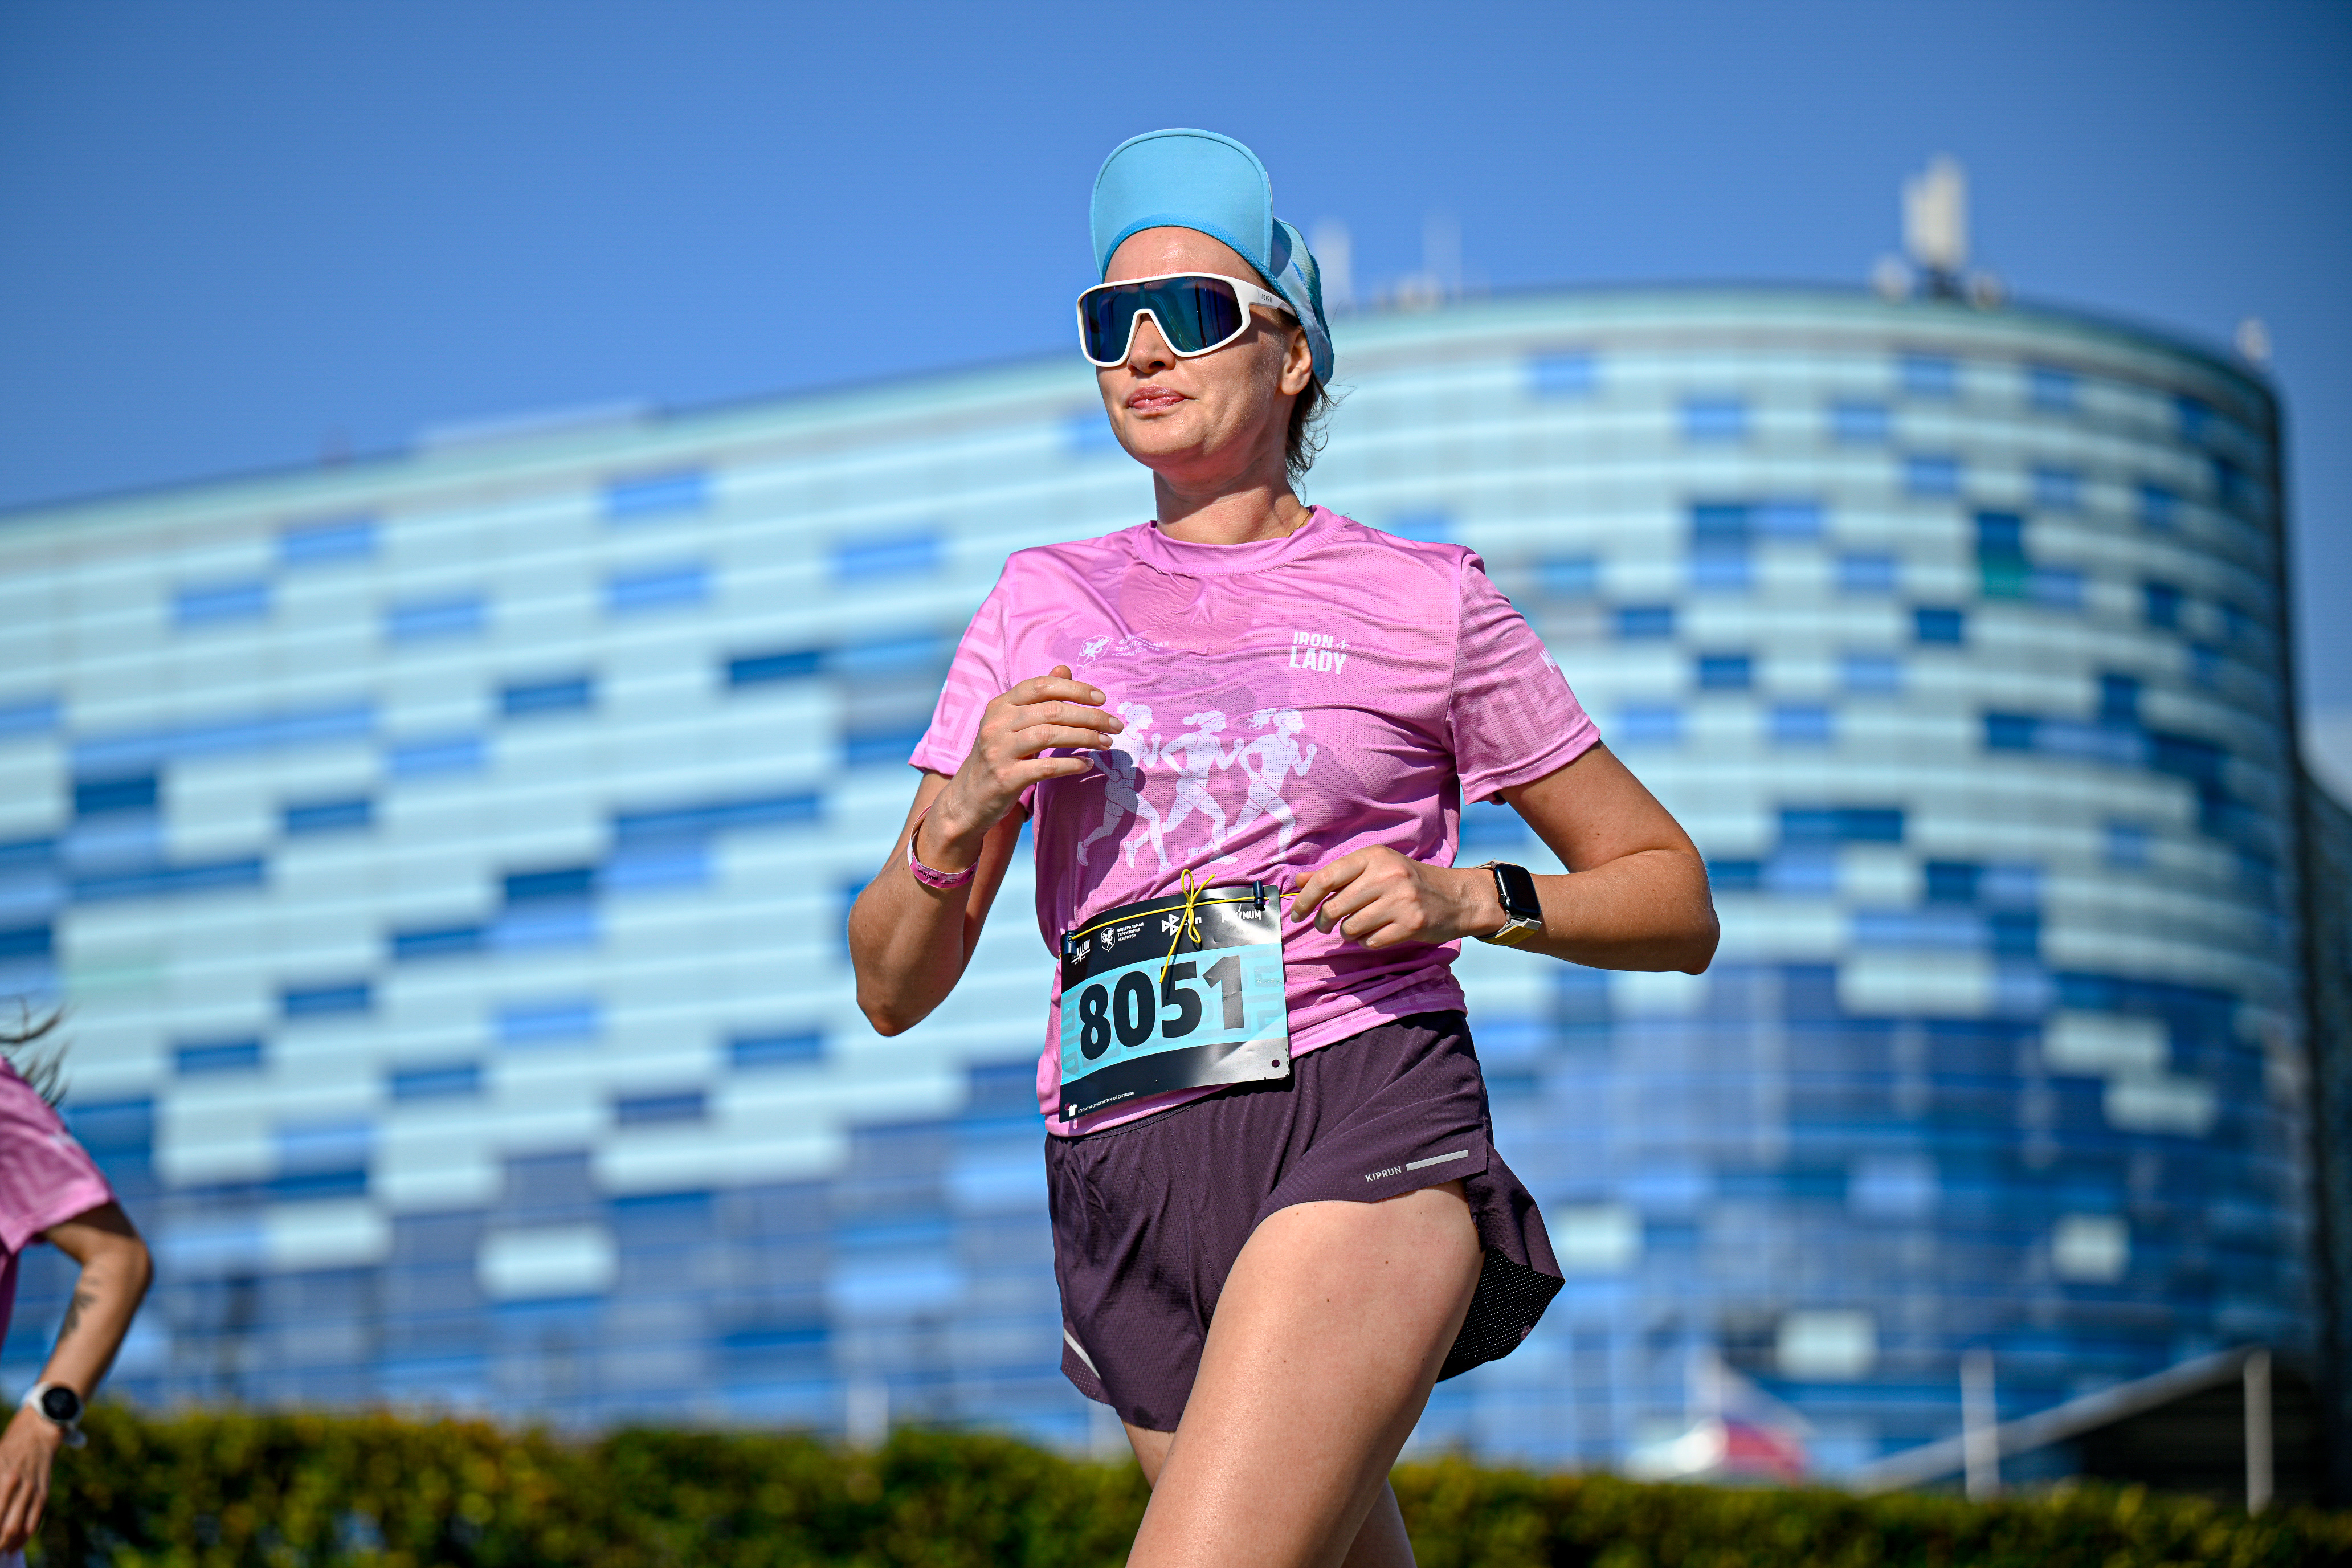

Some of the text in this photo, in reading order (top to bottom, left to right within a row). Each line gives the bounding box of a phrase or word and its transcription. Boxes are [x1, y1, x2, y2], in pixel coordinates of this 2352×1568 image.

[1261, 293, 1272, 303] ocean
[1292, 631, 1333, 648] IRON
[1289, 646, 1348, 675] LADY
[1221, 903, 1261, 923] MXIMUM
[1117, 922, 1144, 932] ФЕДЕРАЛЬНАЯ
[1117, 928, 1141, 937] ТЕРРИТОРИЯ
[1079, 955, 1245, 1060] 8051
[1365, 1166, 1402, 1182] KIPRUN
